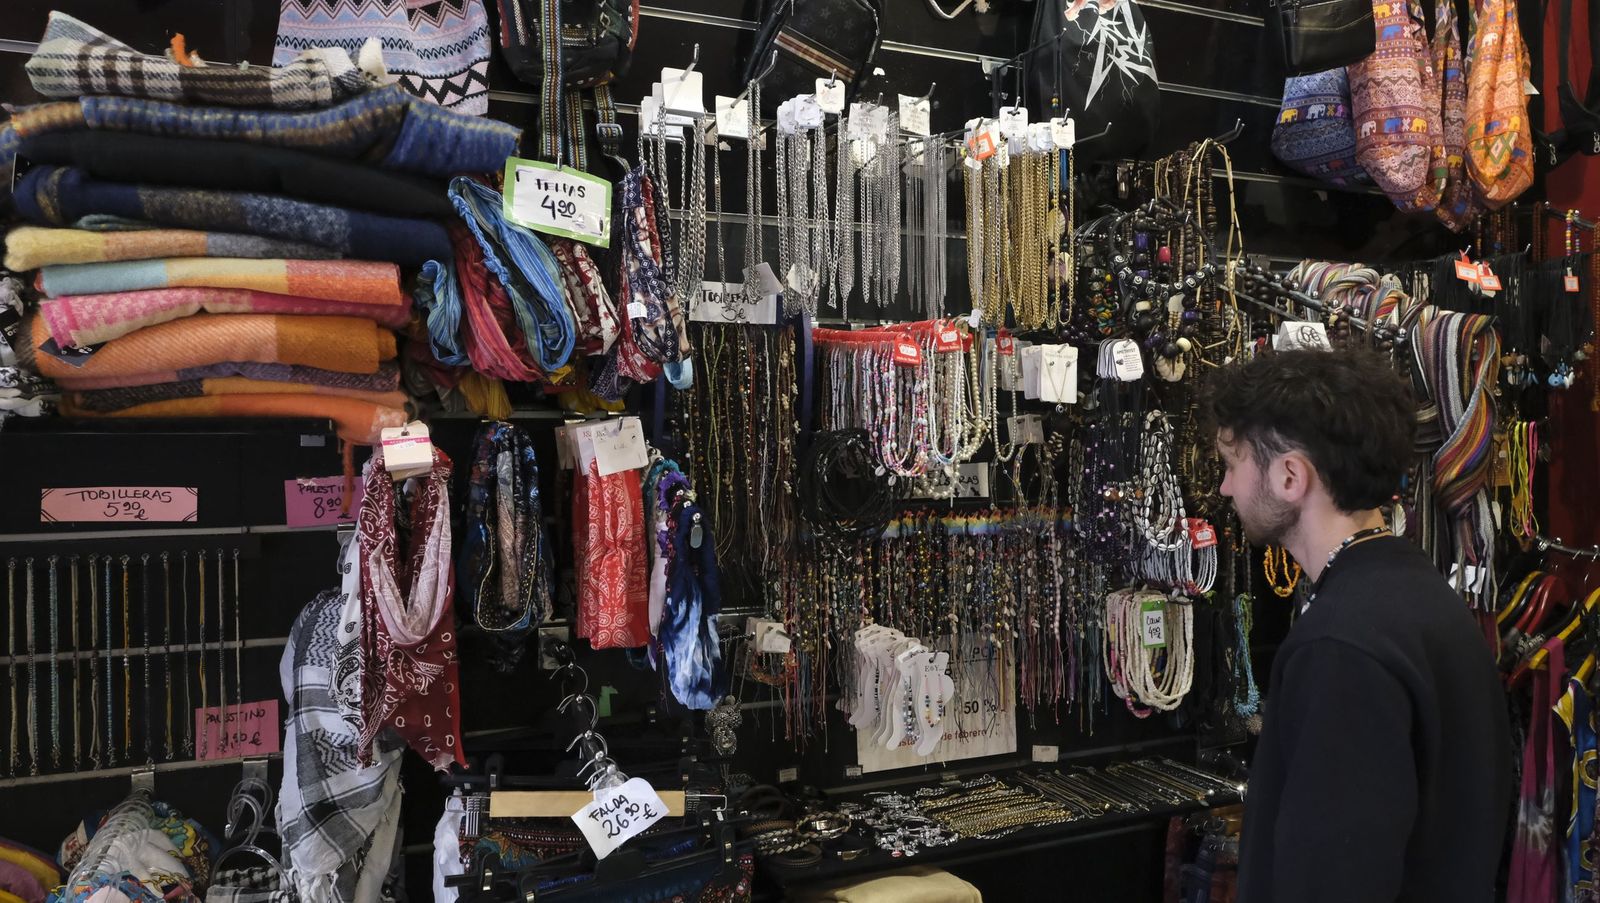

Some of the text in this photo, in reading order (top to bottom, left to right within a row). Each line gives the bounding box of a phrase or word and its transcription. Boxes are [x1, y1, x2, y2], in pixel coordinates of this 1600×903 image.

[65, 489, 172, 503] TOBILLERAS
[963, 700, 980, 715] 50
[588, 794, 629, 822] FALDA
